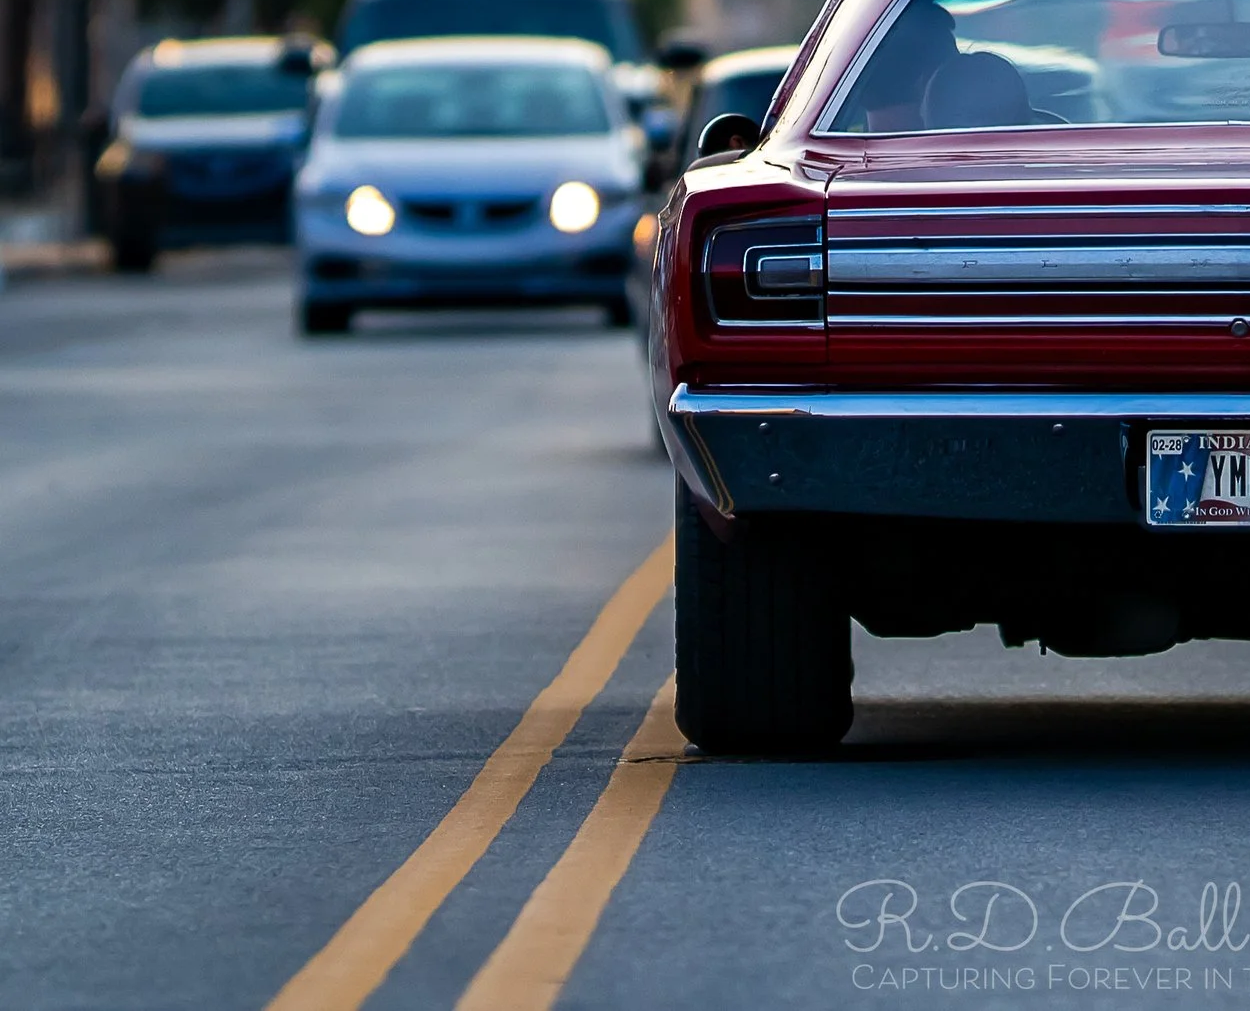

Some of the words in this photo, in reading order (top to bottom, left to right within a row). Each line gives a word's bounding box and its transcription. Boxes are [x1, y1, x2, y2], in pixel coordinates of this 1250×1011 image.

[1152, 439, 1182, 451] 02-28
[1195, 506, 1207, 516] IN
[1209, 506, 1233, 516] GOD
